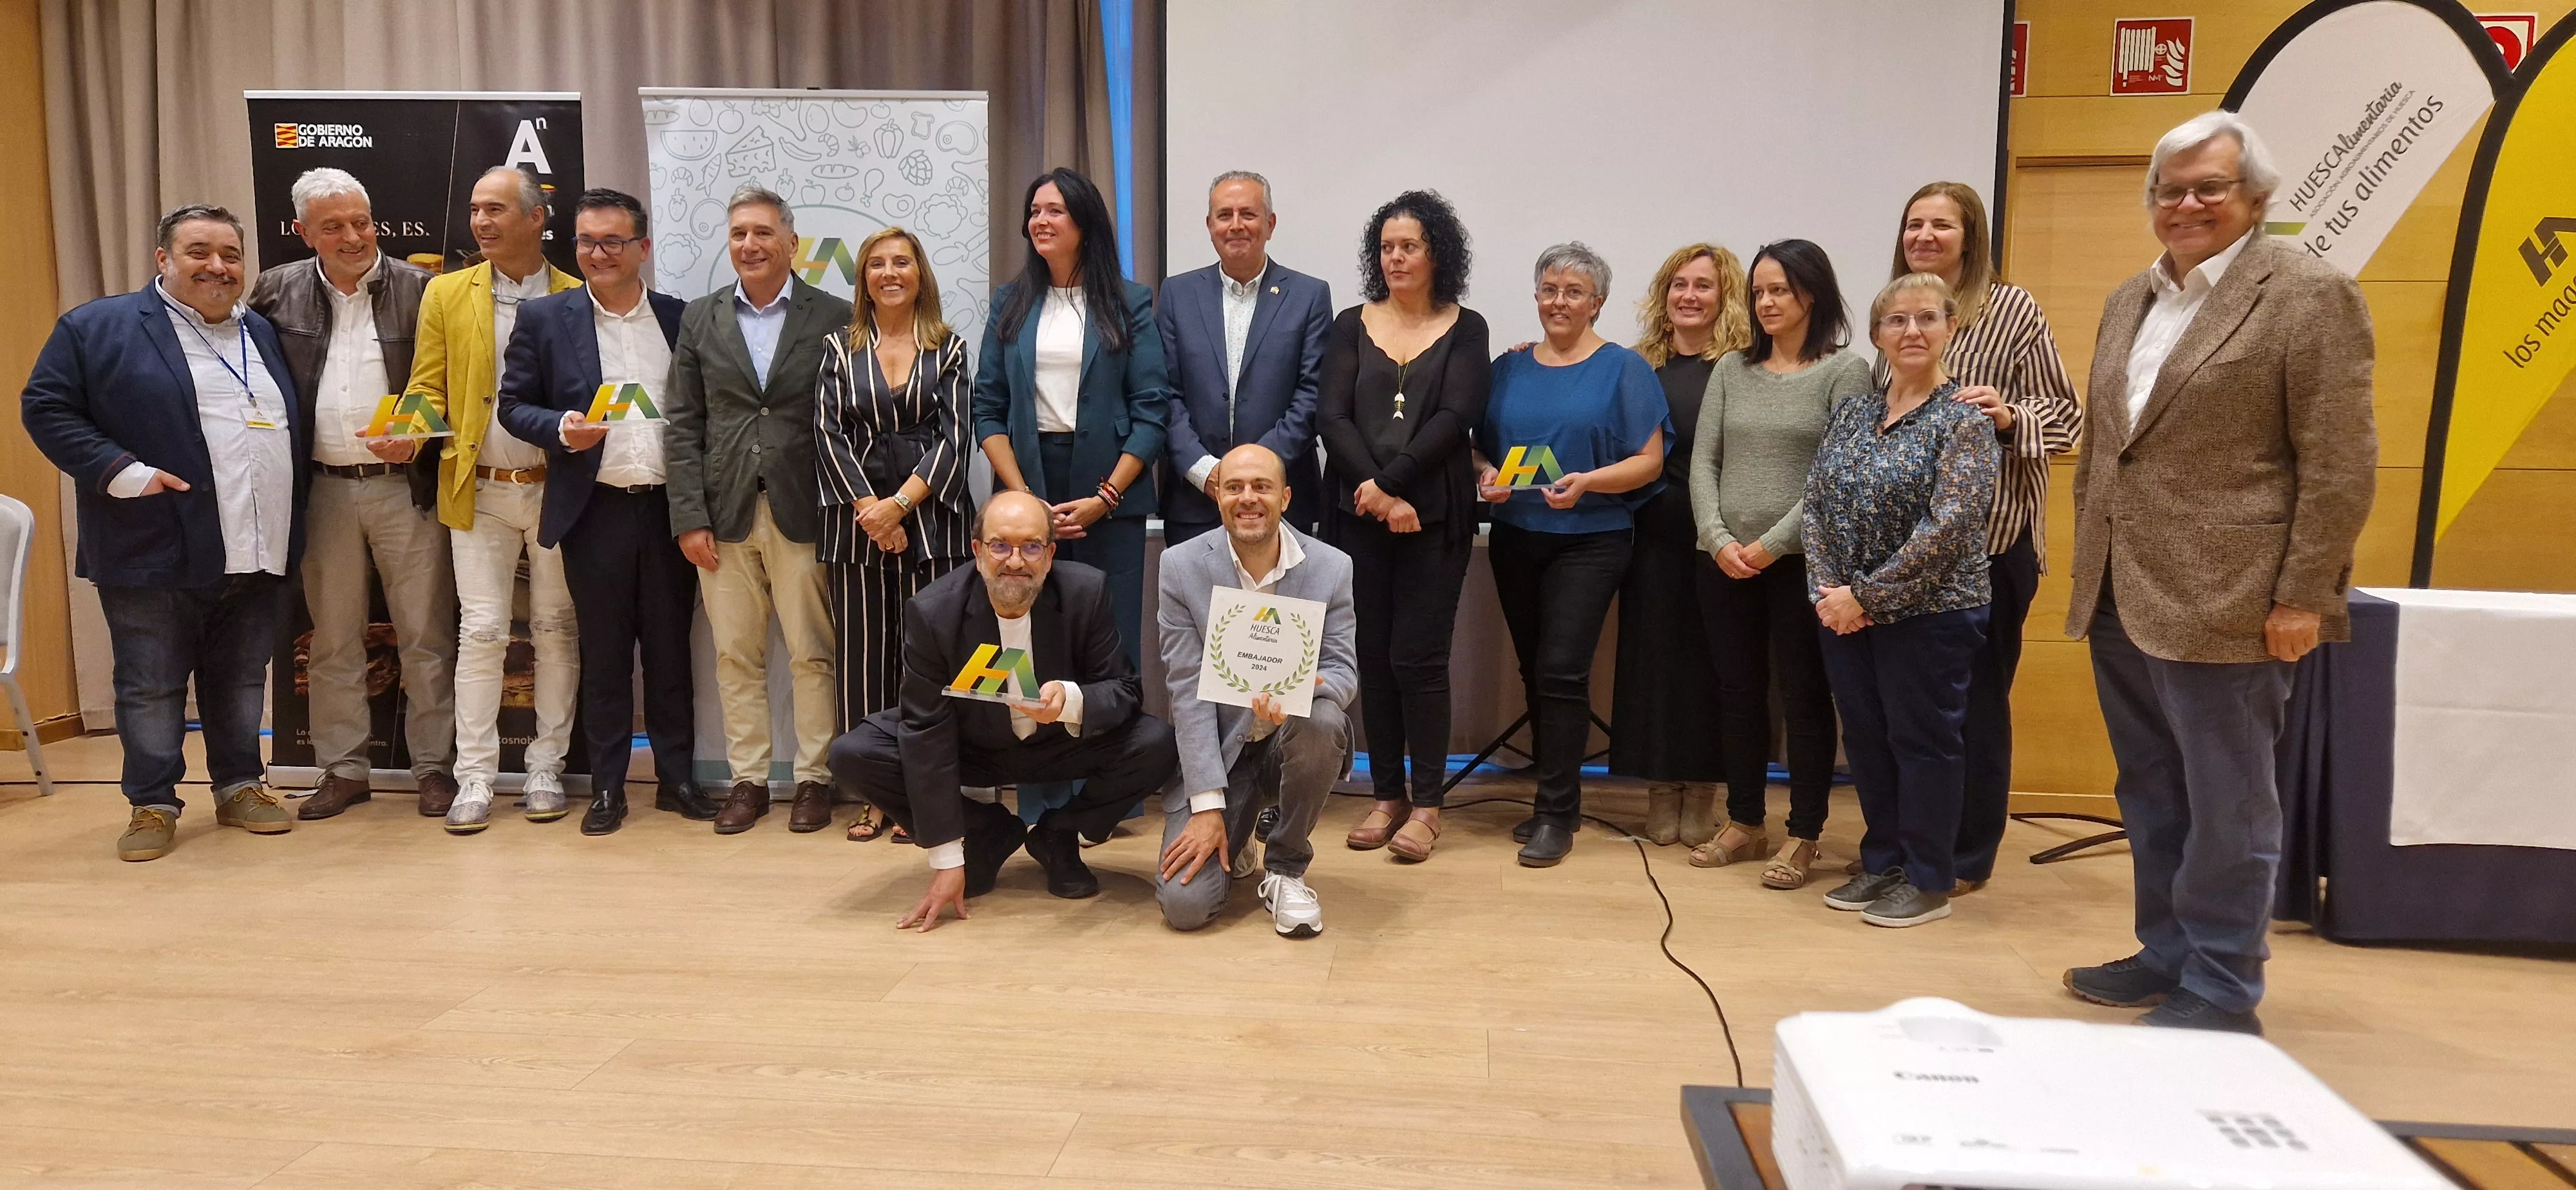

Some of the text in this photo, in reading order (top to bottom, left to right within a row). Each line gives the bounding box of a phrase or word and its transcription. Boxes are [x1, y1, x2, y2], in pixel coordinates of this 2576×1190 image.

[298, 124, 363, 136] GOBIERNO
[298, 137, 315, 147] DE
[2325, 200, 2359, 235] tus
[2355, 95, 2443, 202] alimentos
[402, 221, 430, 236] ES.
[2503, 334, 2541, 369] los
[1250, 623, 1280, 636] HUESCA
[1237, 651, 1283, 665] EMBAJADOR
[1251, 663, 1267, 672] 2024
